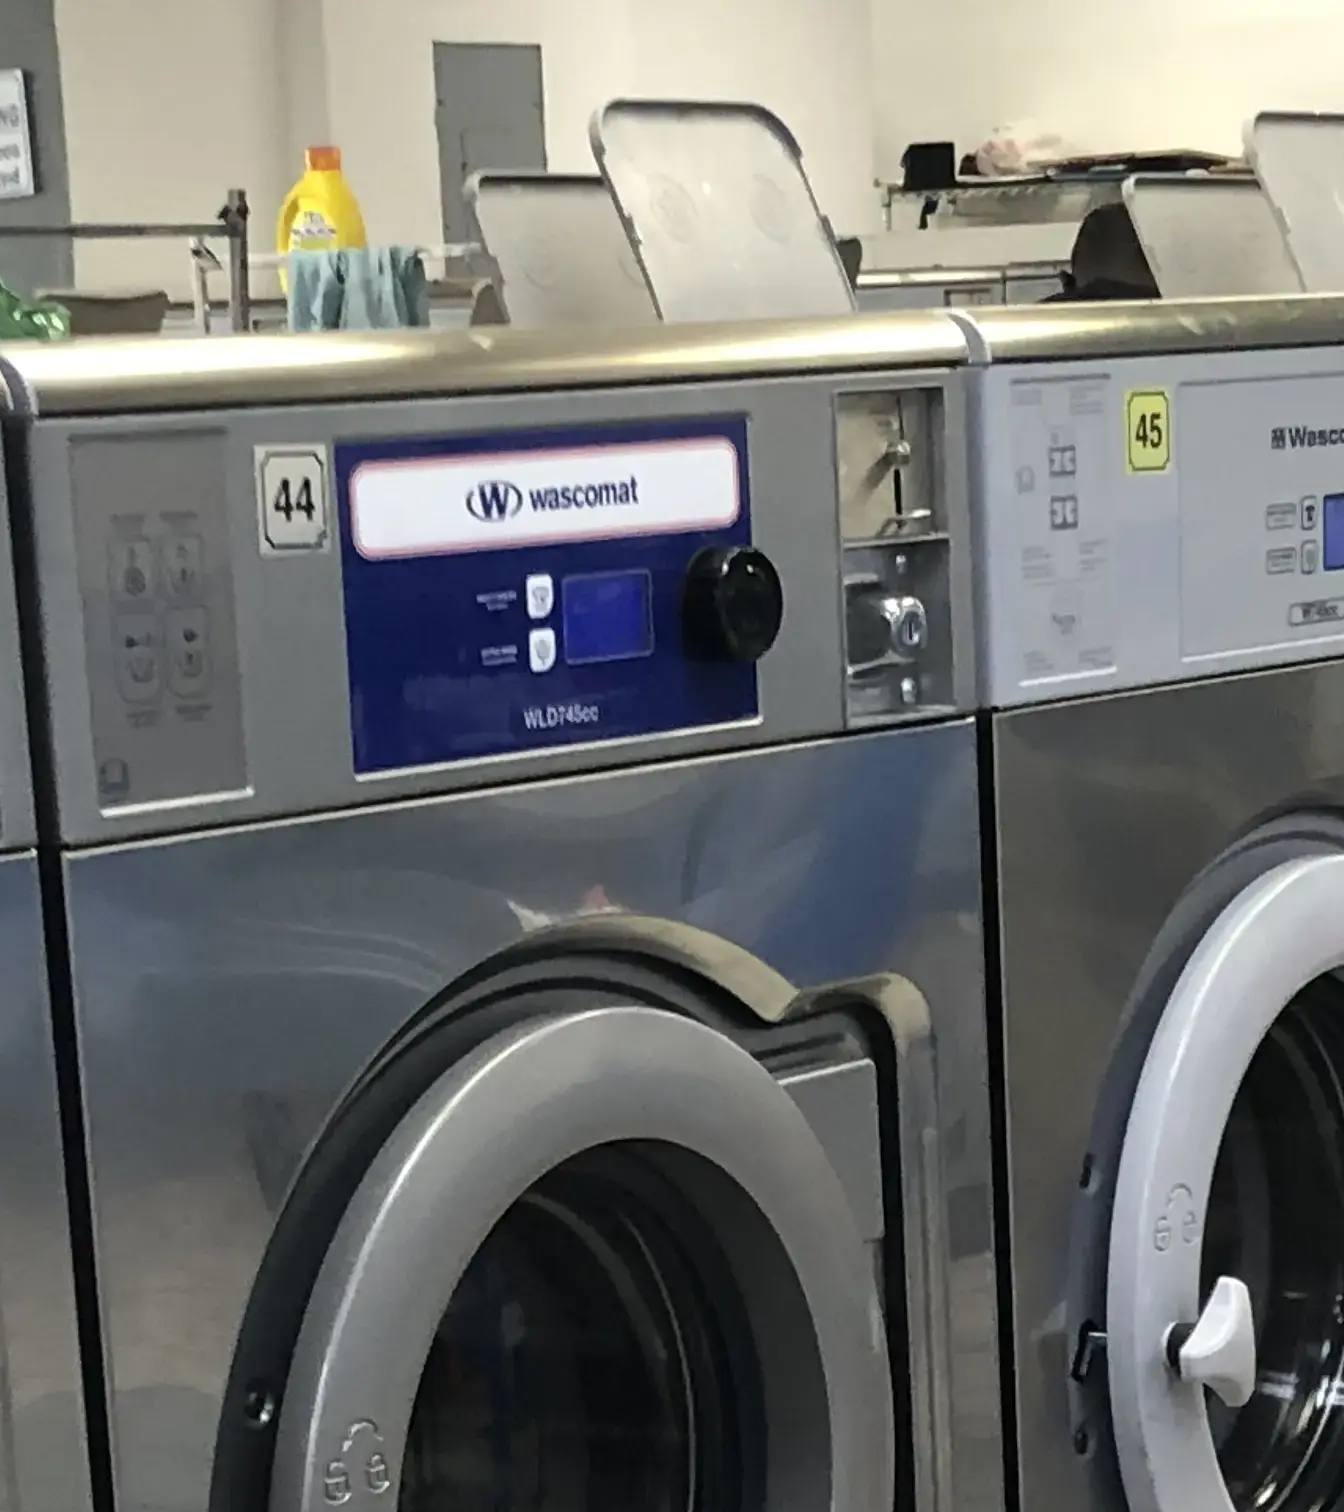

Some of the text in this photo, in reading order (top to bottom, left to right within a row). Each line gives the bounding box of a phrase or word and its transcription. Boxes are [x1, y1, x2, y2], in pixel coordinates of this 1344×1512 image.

[1134, 412, 1164, 450] 45
[273, 476, 316, 523] 44
[529, 474, 640, 512] wascomat
